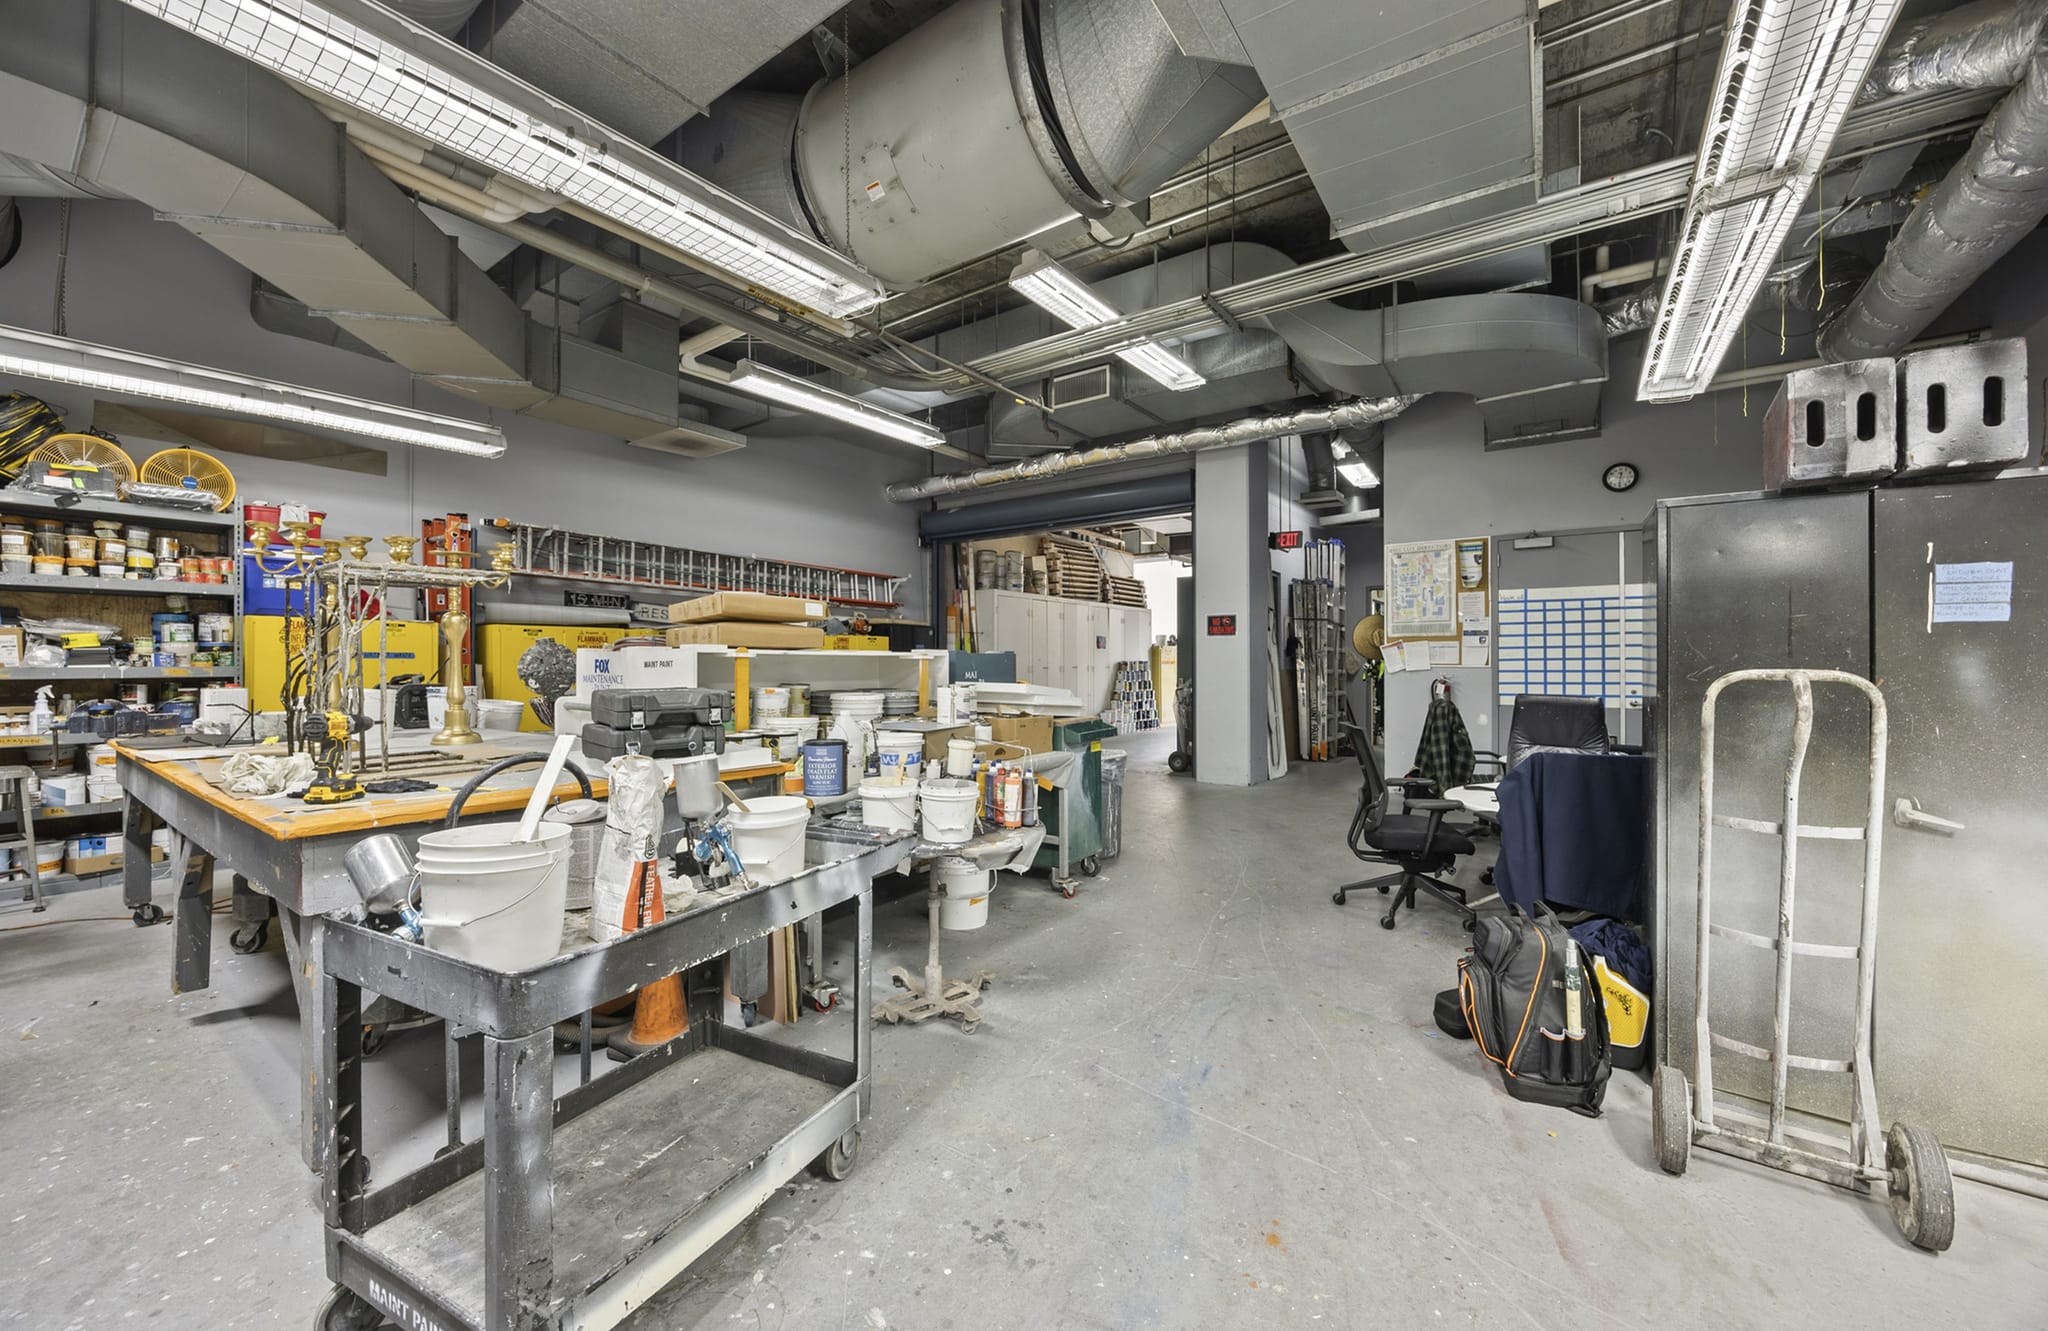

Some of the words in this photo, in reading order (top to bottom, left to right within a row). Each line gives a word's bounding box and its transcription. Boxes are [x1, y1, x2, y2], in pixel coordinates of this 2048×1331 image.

[1280, 532, 1299, 548] EXIT
[1211, 617, 1220, 626] NO
[594, 659, 610, 674] FOX
[643, 660, 658, 668] MAINT
[659, 660, 674, 668] PAINT
[582, 674, 624, 685] MAINTENANCE
[644, 865, 655, 908] FEATHER
[369, 1279, 409, 1320] MAINT
